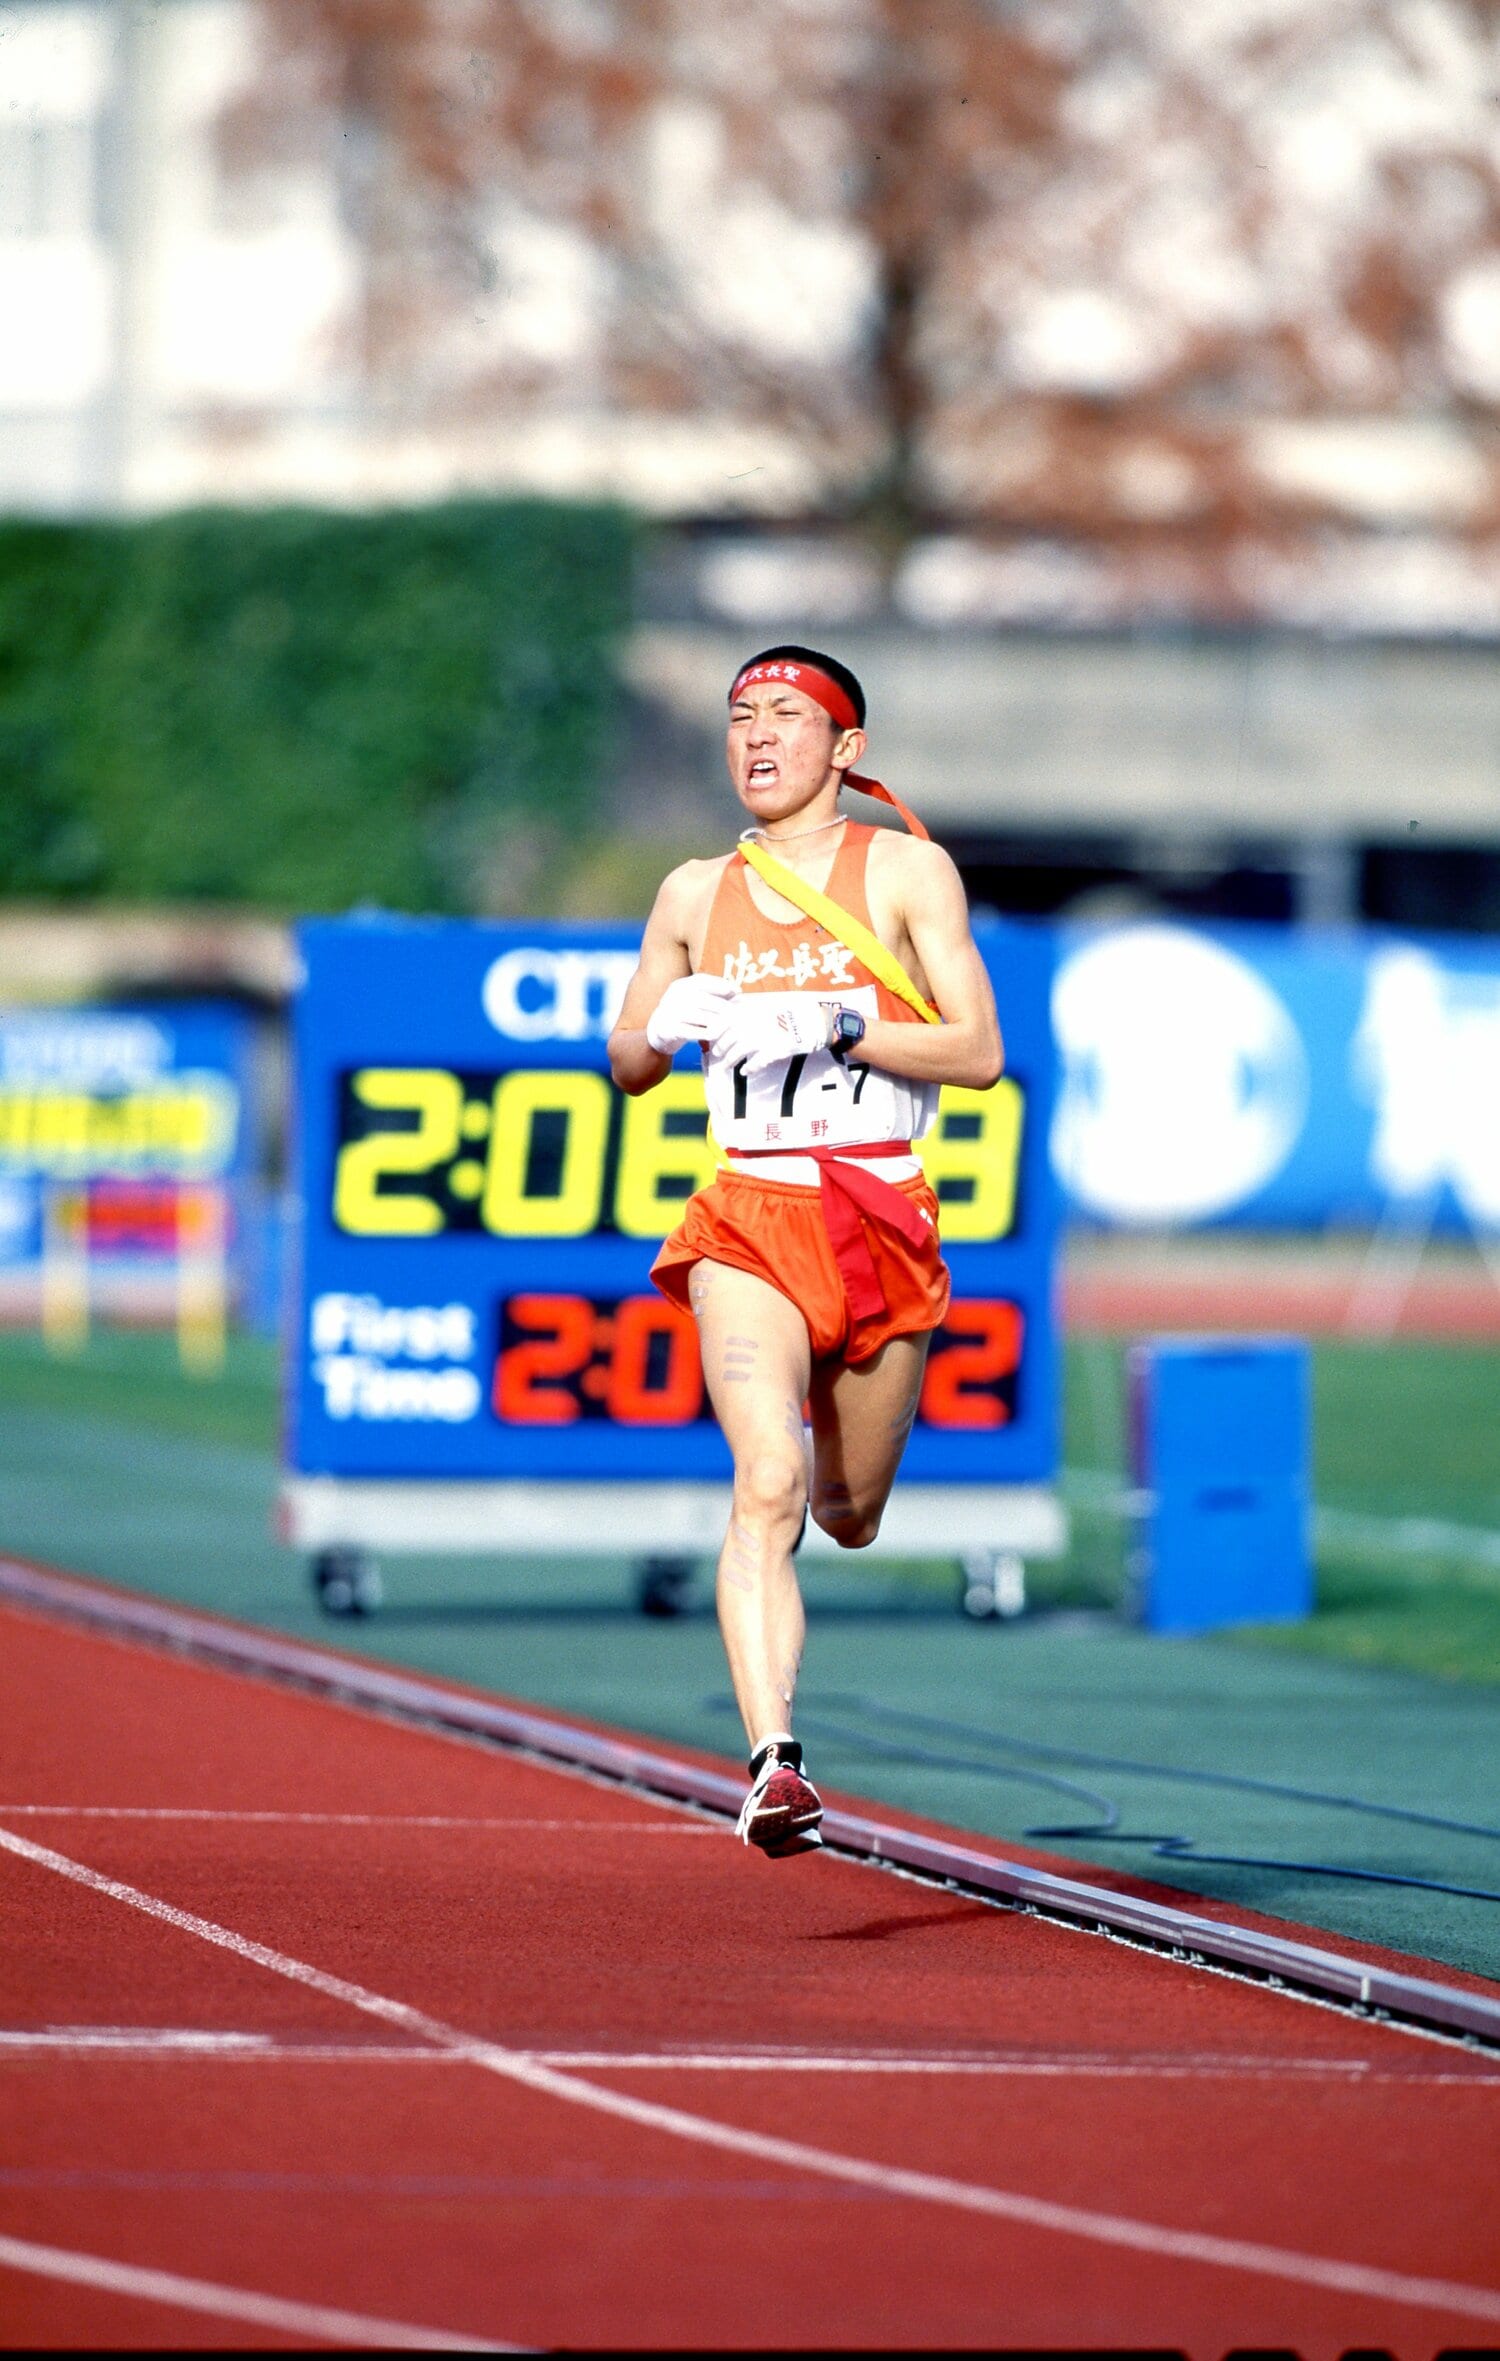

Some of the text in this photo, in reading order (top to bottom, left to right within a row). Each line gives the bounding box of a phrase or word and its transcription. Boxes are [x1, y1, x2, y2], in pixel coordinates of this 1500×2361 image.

[722, 940, 855, 986] 佐久長聖
[766, 1119, 829, 1141] 長野
[312, 1293, 477, 1360] First
[313, 1355, 480, 1422] Time
